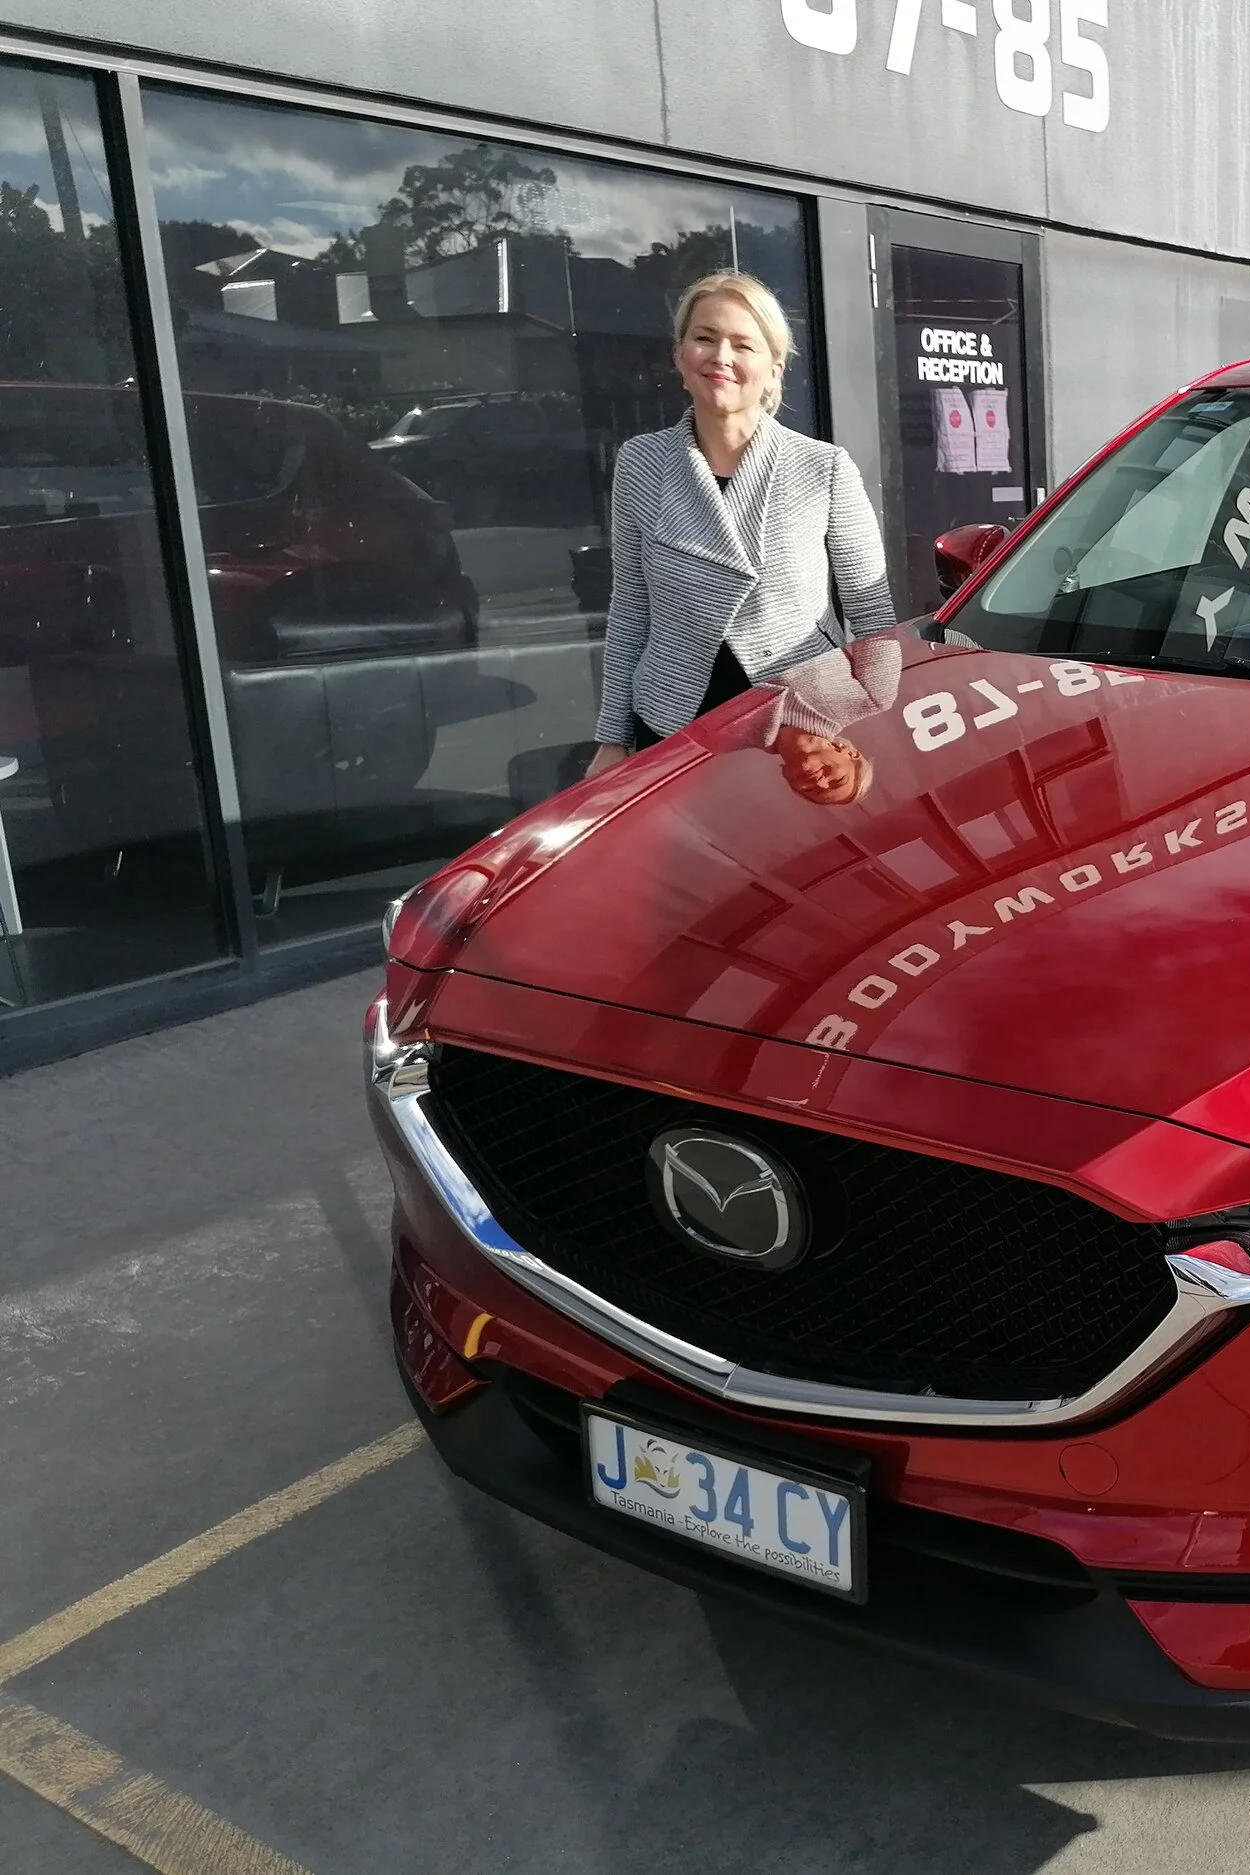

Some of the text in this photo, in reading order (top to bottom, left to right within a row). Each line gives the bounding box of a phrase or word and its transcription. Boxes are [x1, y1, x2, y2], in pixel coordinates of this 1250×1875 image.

[920, 327, 993, 357] OFFICE &
[917, 356, 1004, 385] RECEPTION
[610, 1490, 675, 1526] Tasmania
[735, 1533, 761, 1555] the
[764, 1548, 841, 1583] possibilities
